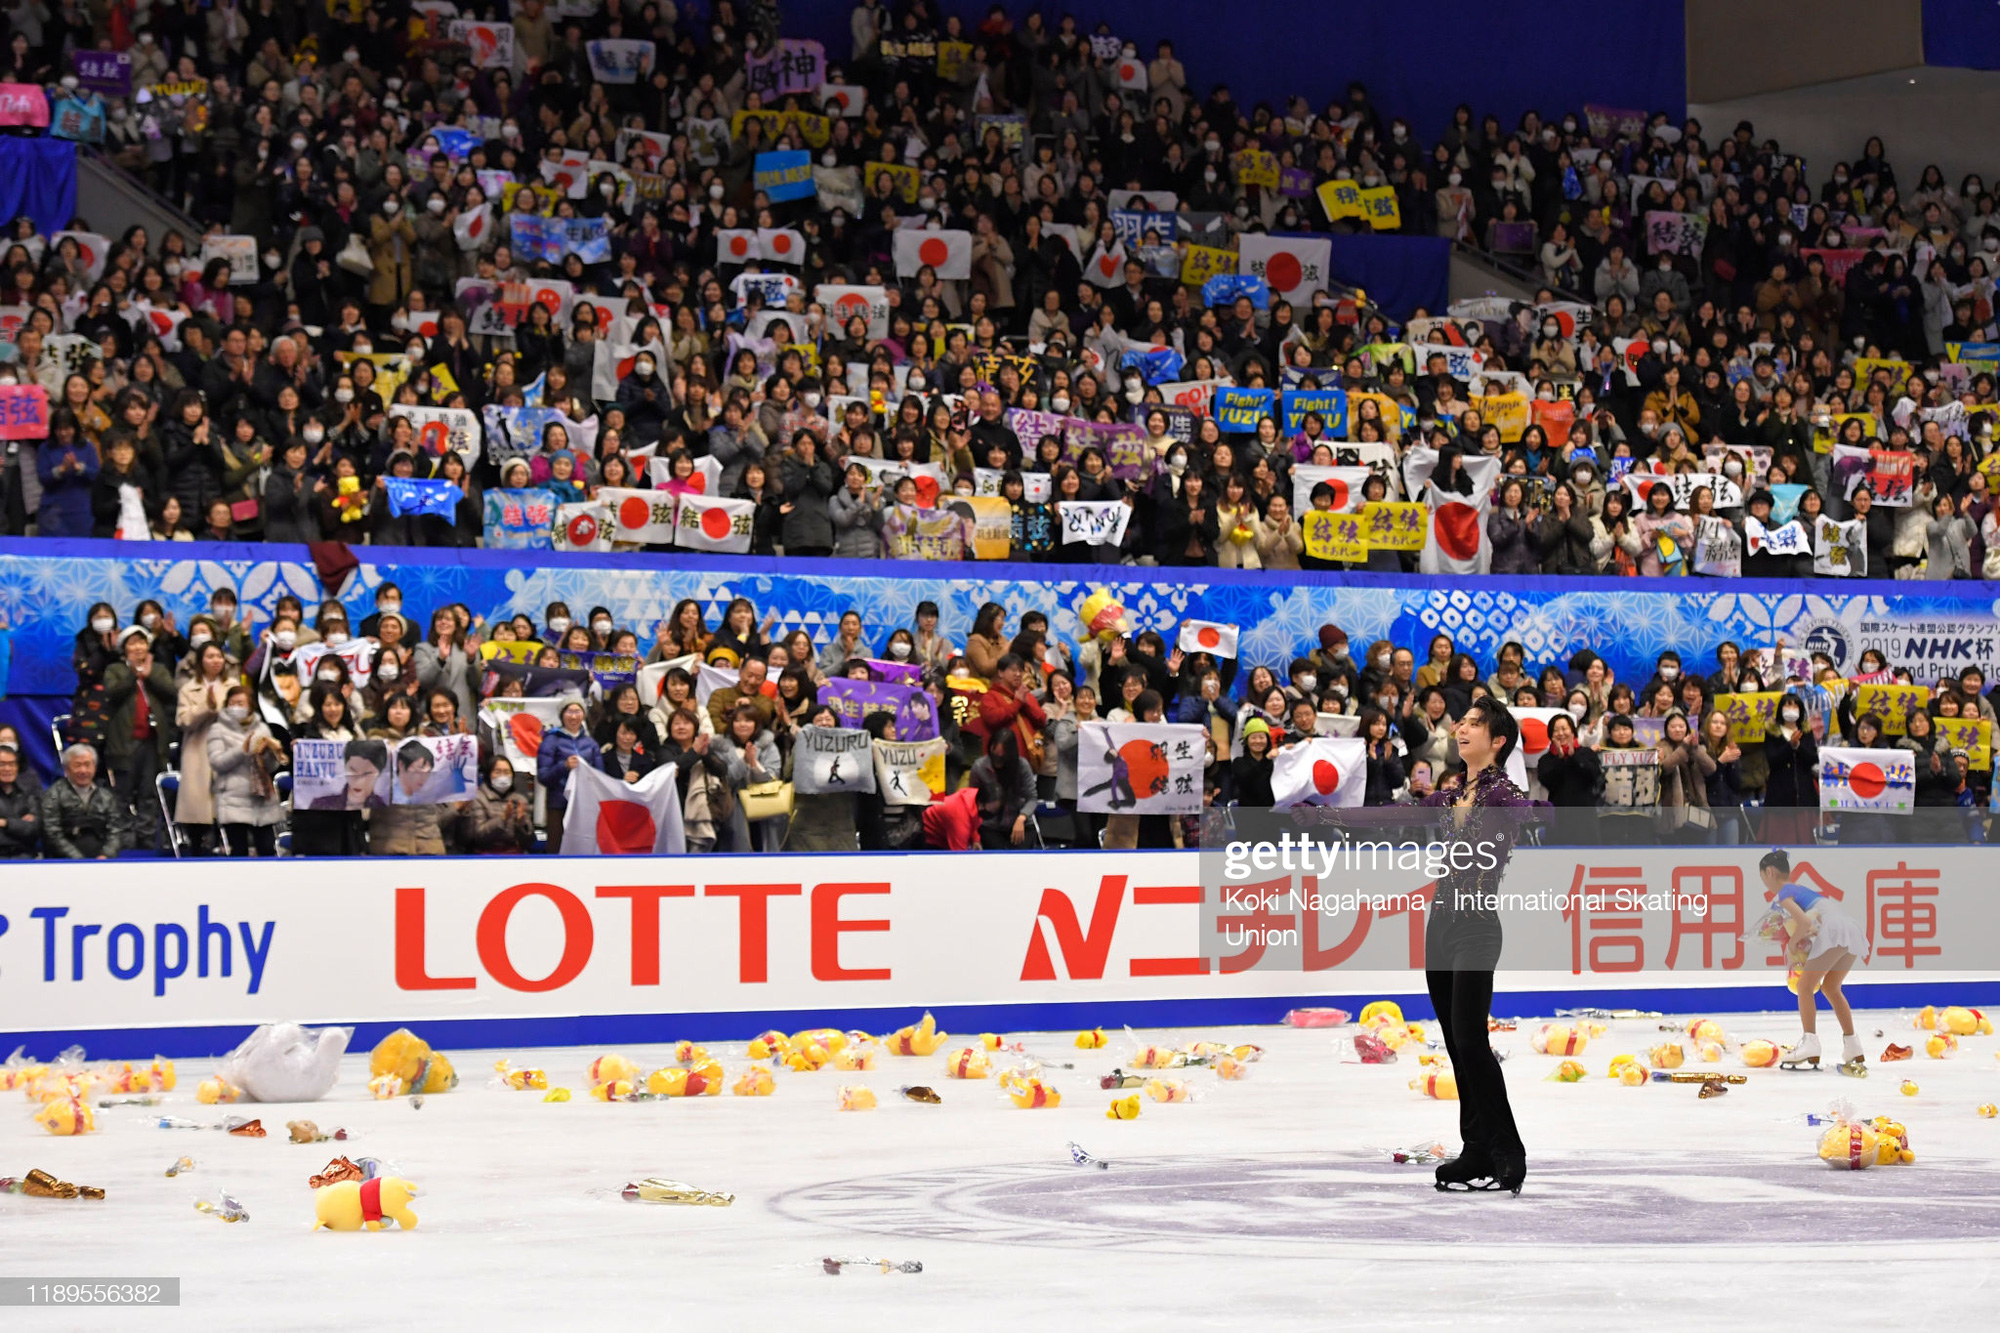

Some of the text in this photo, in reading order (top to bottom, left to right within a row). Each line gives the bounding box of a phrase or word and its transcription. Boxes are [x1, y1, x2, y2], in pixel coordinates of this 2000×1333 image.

[1114, 212, 1172, 243] 羽生
[1223, 393, 1267, 408] Fight!
[1292, 397, 1336, 411] Fight!
[1930, 663, 1958, 678] Prix
[803, 730, 869, 753] YUZURU
[1150, 740, 1194, 761] 羽生
[296, 743, 344, 760] YUZURU
[878, 747, 917, 766] YUZU
[1603, 753, 1626, 765] FLY
[296, 762, 337, 779] HANYU
[396, 883, 890, 992] LOTTE
[30, 905, 276, 997] Trophy
